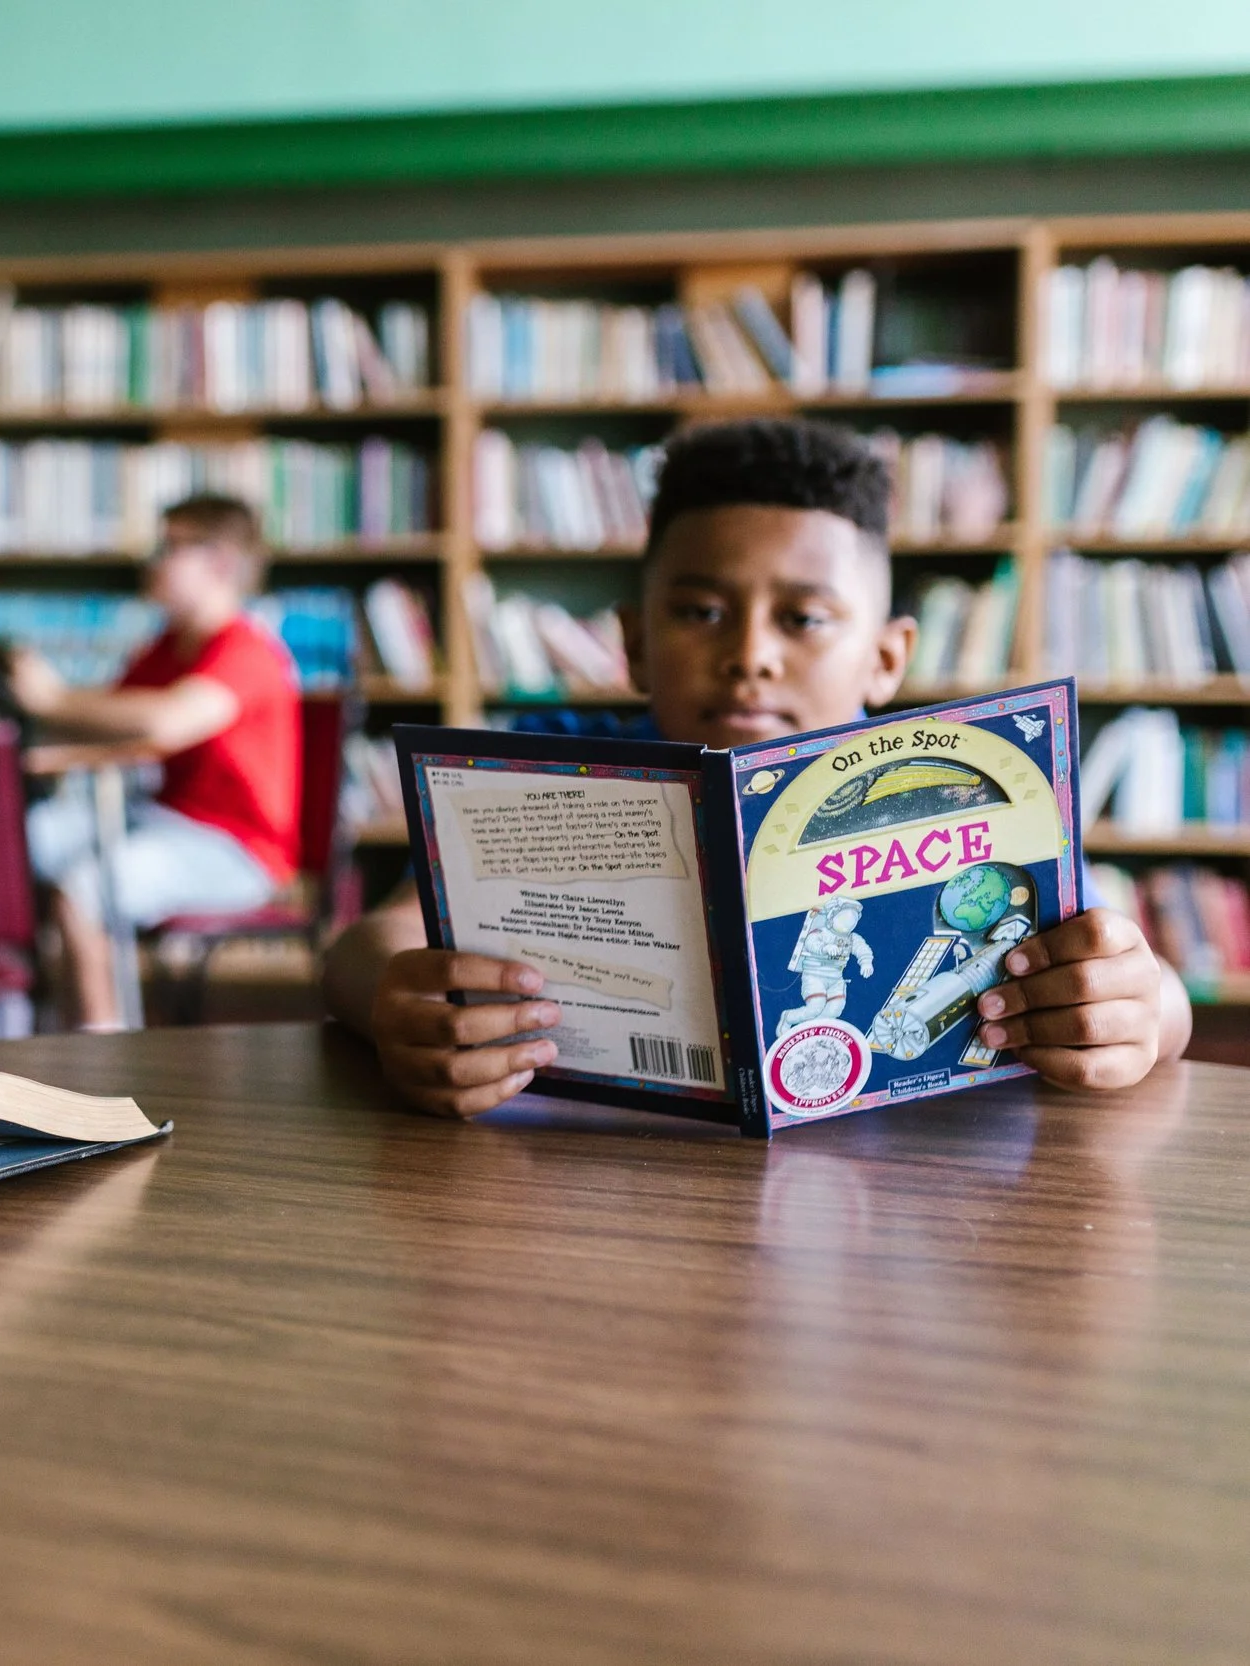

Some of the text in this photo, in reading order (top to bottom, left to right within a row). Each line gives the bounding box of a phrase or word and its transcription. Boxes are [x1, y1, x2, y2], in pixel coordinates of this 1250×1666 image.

[832, 730, 960, 772] On the Spot
[524, 792, 541, 800] YOU
[542, 792, 557, 800] ARE
[481, 806, 494, 815] you
[551, 802, 560, 810] of
[562, 801, 585, 810] taking
[593, 800, 609, 808] ride
[622, 798, 635, 806] the
[636, 799, 658, 807] space
[537, 813, 563, 823] thought
[565, 811, 574, 819] of
[576, 812, 599, 821] seeing
[607, 809, 623, 817] real
[546, 823, 563, 831] beat
[565, 821, 593, 830] faster?
[595, 820, 619, 829] Here's
[632, 819, 662, 828] exciting
[531, 834, 569, 843] transports
[627, 829, 640, 838] the
[556, 844, 570, 852] and
[572, 842, 611, 850] interactive
[613, 840, 646, 849] features
[647, 840, 661, 848] like
[561, 855, 577, 863] your
[579, 852, 609, 861] favorite
[644, 851, 668, 860] topics
[816, 821, 993, 896] SPACE
[515, 866, 528, 874] Get
[531, 865, 552, 874] ready
[553, 863, 566, 873] for
[578, 863, 590, 872] On
[590, 862, 604, 871] the
[604, 861, 622, 872] Spot
[519, 889, 626, 907] Written by Claire Llewellyn
[524, 899, 564, 910] Illustrated
[565, 903, 576, 912] by
[510, 906, 642, 928] Additional artwork by Tony Kenyon
[586, 924, 626, 935] Jacqueline
[628, 929, 654, 939] Mitton
[581, 935, 604, 943] series
[633, 939, 650, 948] Jane
[652, 940, 681, 951] Walker
[548, 954, 559, 964] On
[562, 958, 574, 968] the
[576, 962, 594, 972] Spot
[819, 1028, 854, 1048] CHOICE
[892, 1080, 948, 1097] Children's Books
[893, 1072, 945, 1089] Reader's Digest
